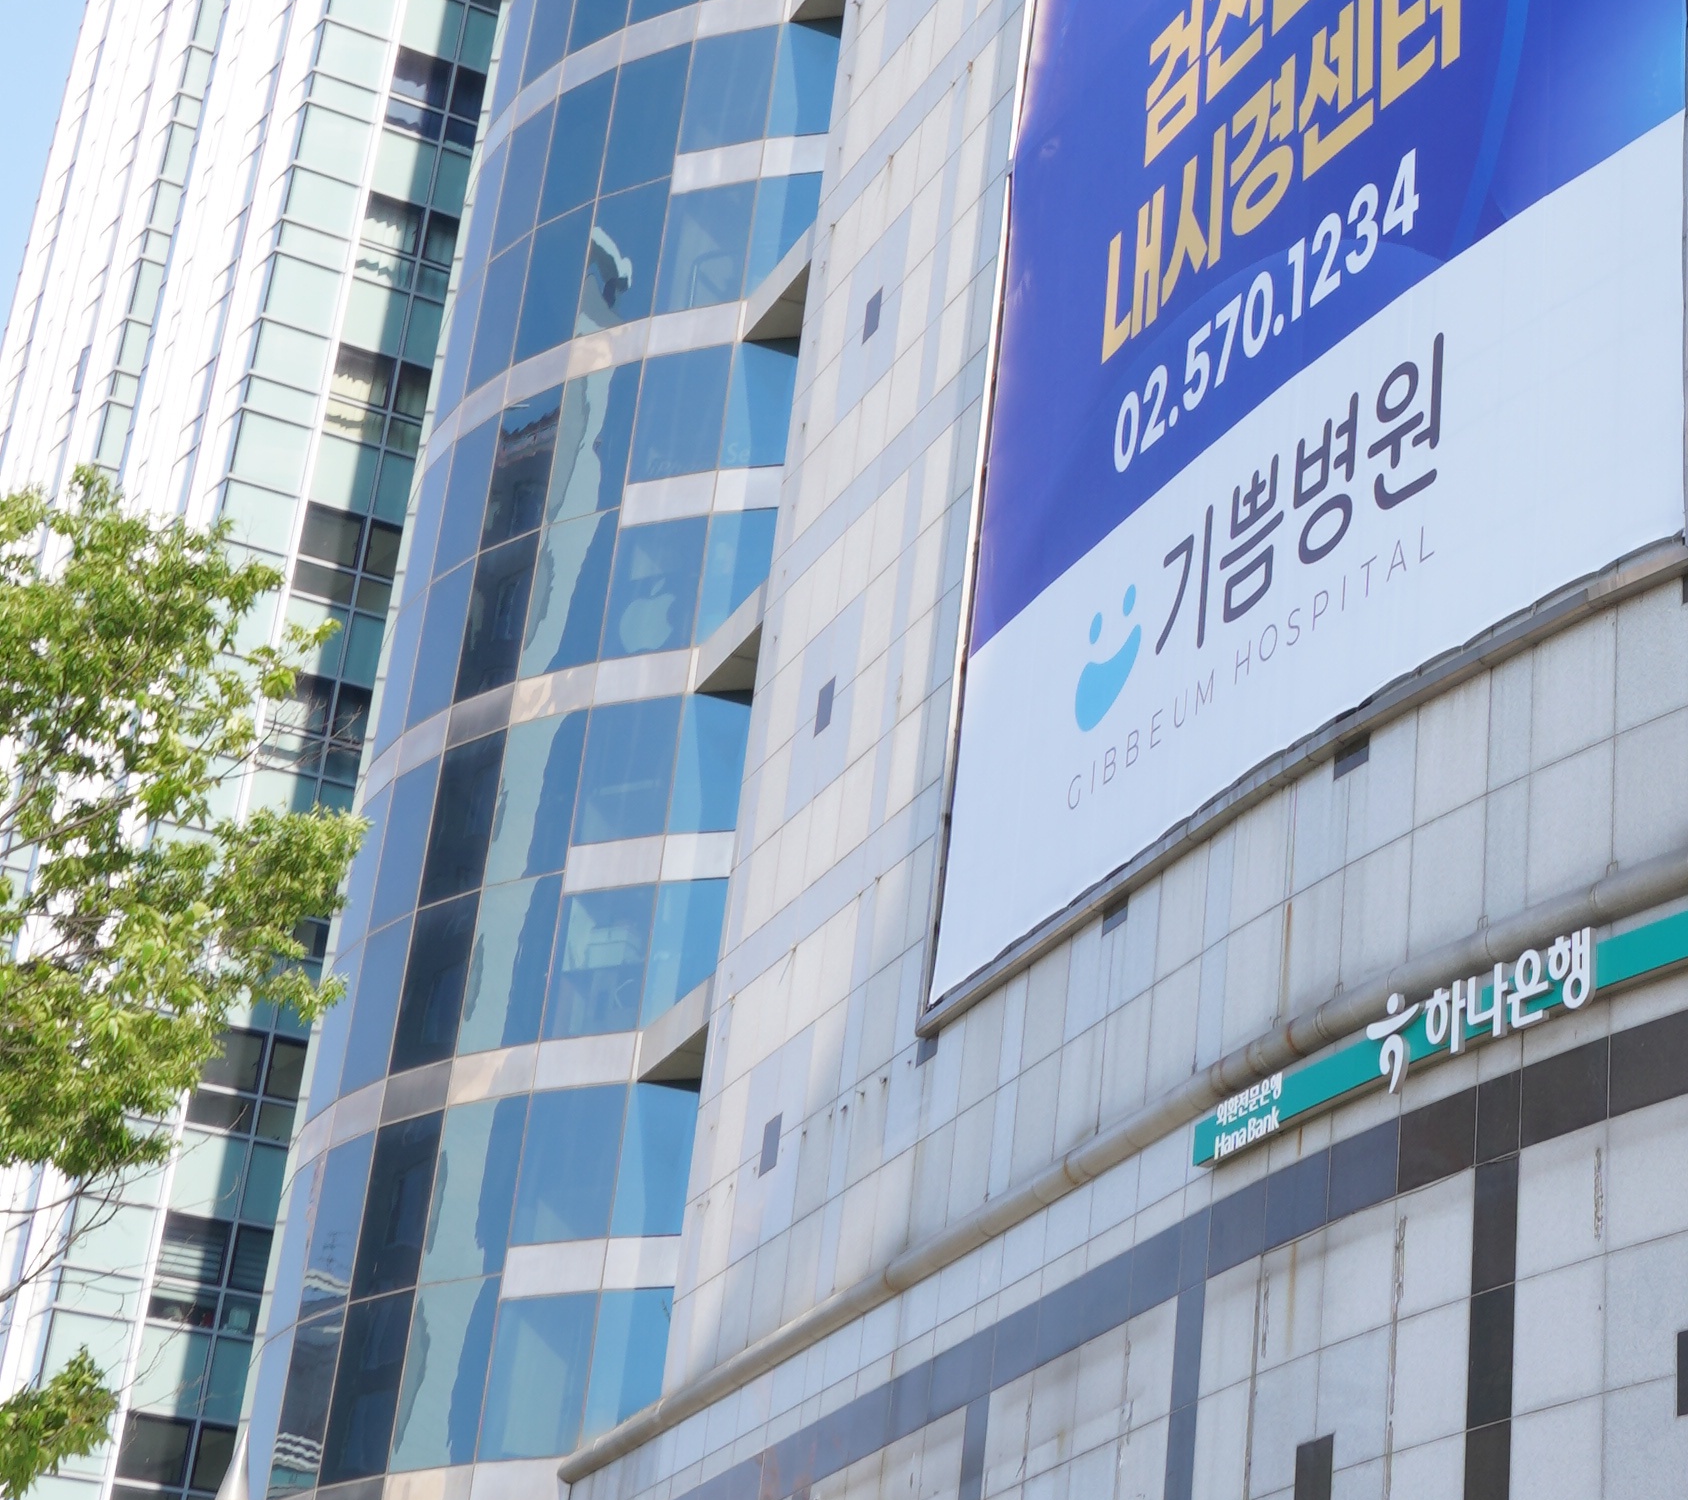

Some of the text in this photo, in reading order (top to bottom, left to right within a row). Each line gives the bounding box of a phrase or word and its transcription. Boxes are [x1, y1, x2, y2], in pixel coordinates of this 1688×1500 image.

[1113, 147, 1419, 473] 02.570.1234
[1155, 332, 1444, 656] 기쁨병원
[1067, 526, 1435, 811] GIBBEUM HOSPITAL
[1425, 926, 1596, 1054] 하나은행
[1214, 1105, 1280, 1160] Hana Bank
[1216, 1071, 1283, 1126] 외환전문은행
